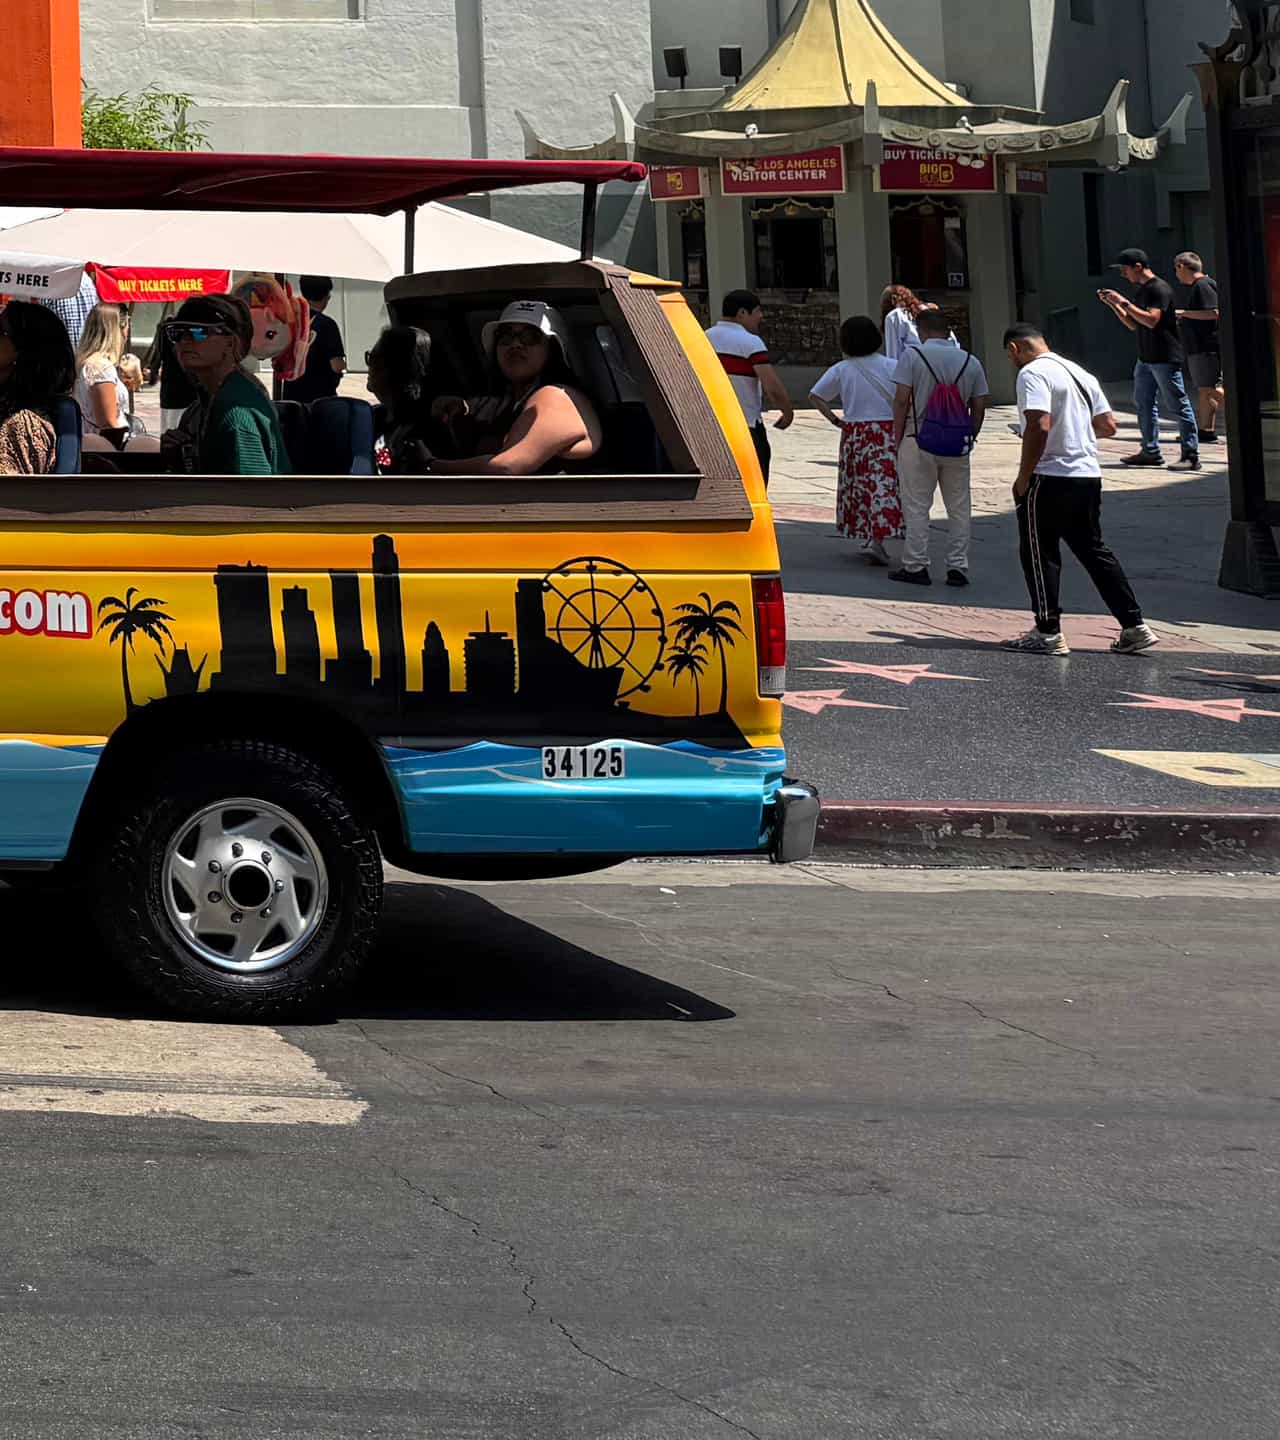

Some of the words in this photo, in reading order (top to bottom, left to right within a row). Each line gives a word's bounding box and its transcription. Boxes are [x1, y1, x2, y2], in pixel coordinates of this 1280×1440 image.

[884, 149, 907, 161] BUY
[909, 149, 957, 161] TICKETS
[763, 159, 785, 170] LOS
[785, 158, 838, 170] ANGELES
[919, 163, 939, 175] BIG
[731, 169, 777, 182] VISITOR
[778, 168, 828, 181] CENTER
[16, 271, 49, 287] HERE
[118, 279, 137, 292] BUY
[139, 279, 176, 292] TICKETS
[177, 278, 203, 291] HERE
[544, 747, 623, 778] 34125
